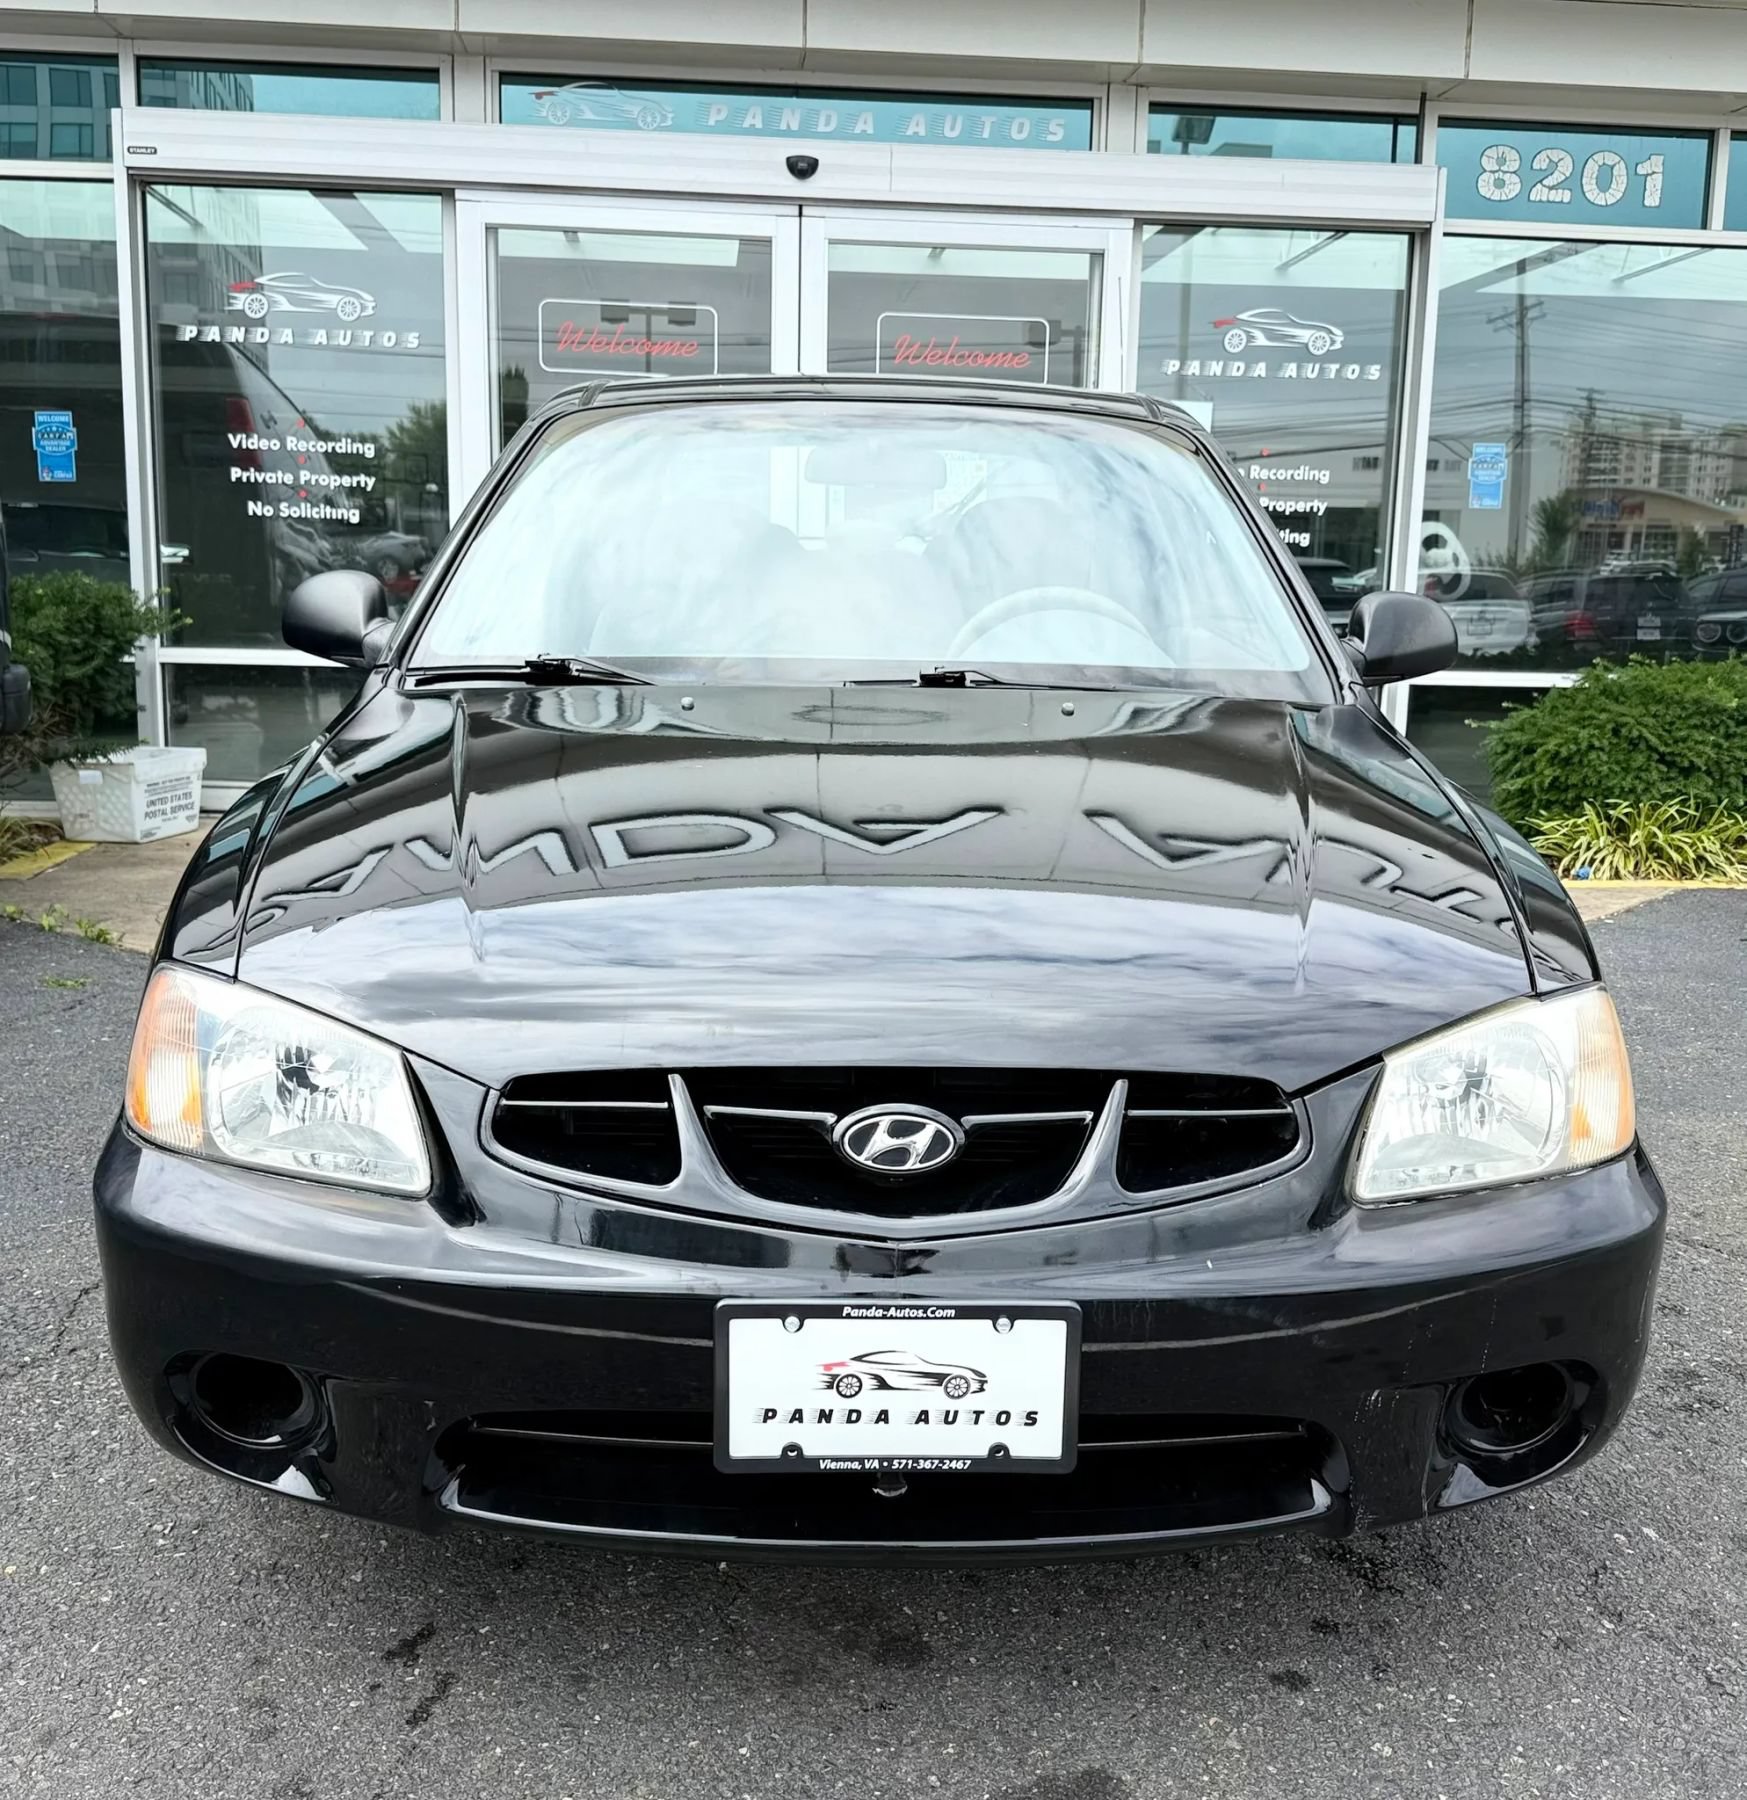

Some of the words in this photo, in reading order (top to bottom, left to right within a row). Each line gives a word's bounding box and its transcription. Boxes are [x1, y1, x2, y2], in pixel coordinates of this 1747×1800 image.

[697, 104, 874, 134] PANDA
[897, 113, 1064, 141] AUTOS
[1477, 144, 1664, 208] 8201
[177, 325, 294, 344] PANDA
[308, 329, 419, 349] AUTOS
[556, 320, 699, 357] Welcome
[894, 334, 1031, 368] Welcome
[1161, 359, 1267, 378] PANDA
[1275, 362, 1381, 380] AUTOS
[228, 433, 281, 450] Video
[286, 436, 375, 458] Recording
[230, 467, 294, 484] Private
[300, 470, 376, 491] Property
[1249, 465, 1330, 485] Recording
[247, 501, 274, 516] No
[279, 502, 360, 524] Soliciting
[1259, 497, 1328, 516] Property
[146, 796, 169, 808] UNITED
[170, 791, 192, 803] STATES
[144, 808, 168, 821] POSTAL
[170, 801, 195, 815] SERVICE
[842, 1306, 956, 1318] Panda-Autos.Com
[752, 1408, 890, 1424] PANDA
[904, 1409, 1039, 1427] AUTOS
[819, 1459, 862, 1470] Vienna,
[864, 1459, 880, 1469] VA
[891, 1459, 972, 1470] 571-367-2467
